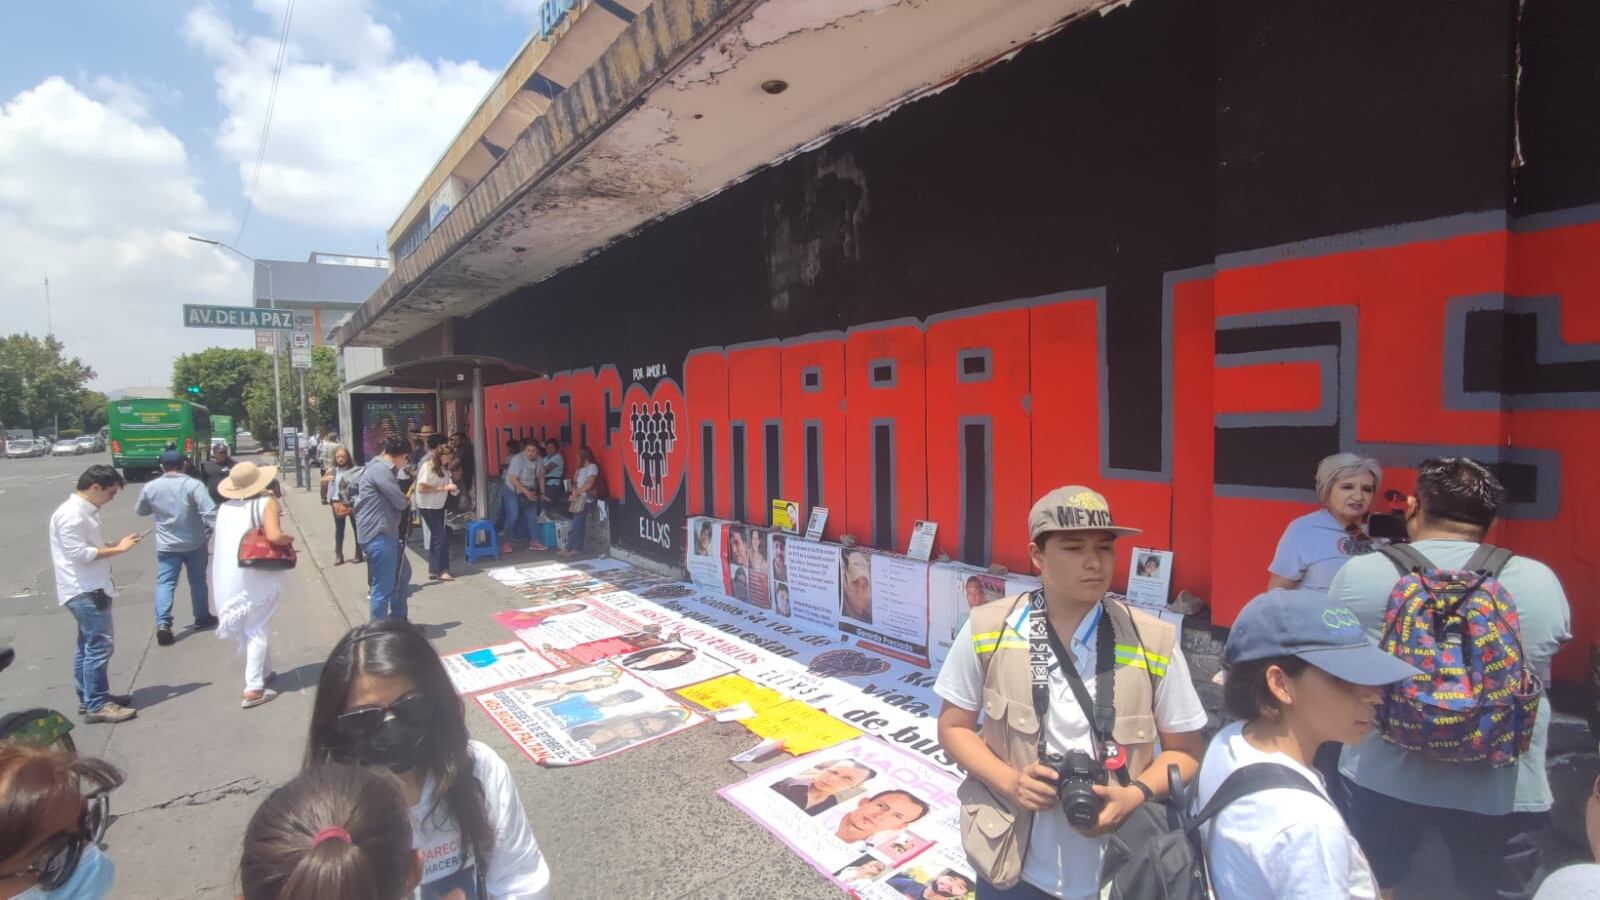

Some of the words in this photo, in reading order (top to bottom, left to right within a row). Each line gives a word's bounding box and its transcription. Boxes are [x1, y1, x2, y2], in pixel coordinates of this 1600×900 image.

[188, 308, 215, 324] AV.
[216, 310, 237, 324] DE
[240, 311, 258, 326] LA
[261, 312, 292, 327] PAZ
[632, 367, 644, 381] POR
[645, 364, 662, 379] AMOR
[1056, 505, 1114, 528] MEXIC
[639, 516, 671, 549] ELLXS
[766, 621, 803, 636] voz
[798, 633, 832, 647] de
[841, 707, 889, 731] de
